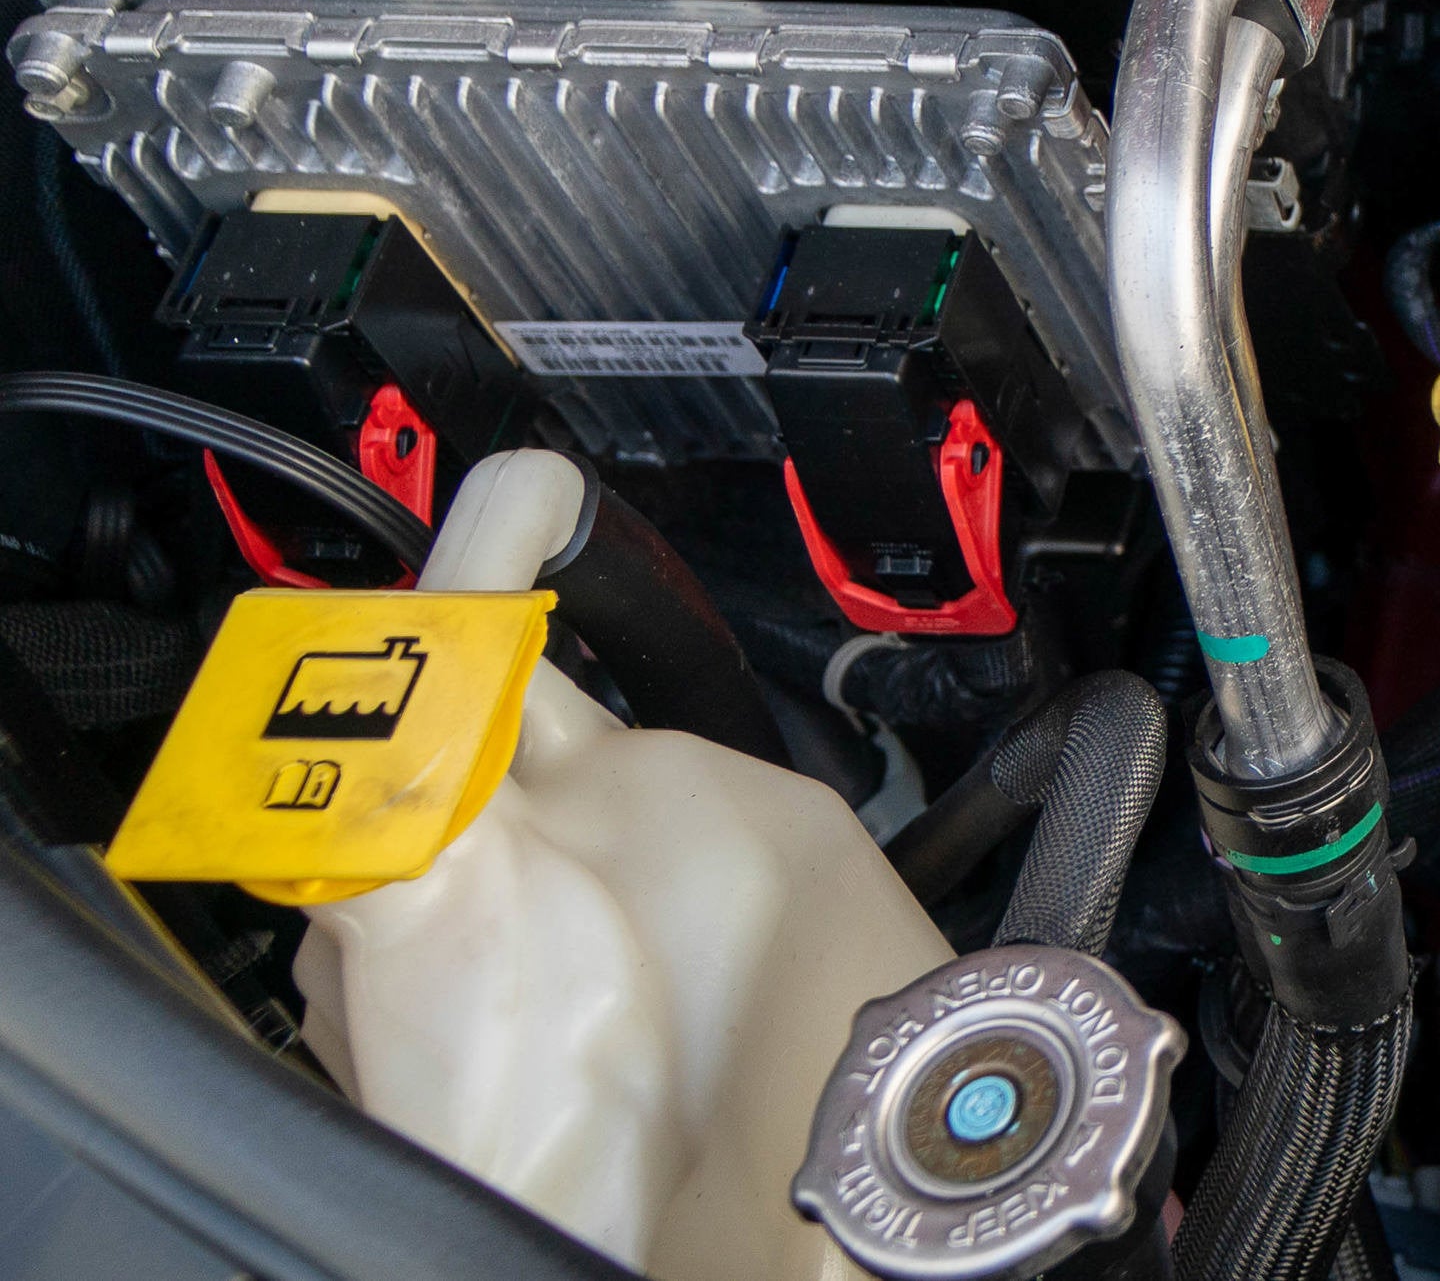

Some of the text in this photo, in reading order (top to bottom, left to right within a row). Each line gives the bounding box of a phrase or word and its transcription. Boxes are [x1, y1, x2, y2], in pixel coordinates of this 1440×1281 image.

[847, 963, 1129, 1105] DO NOT OPEN HOT
[833, 1163, 1070, 1249] KEEP TIGHT
